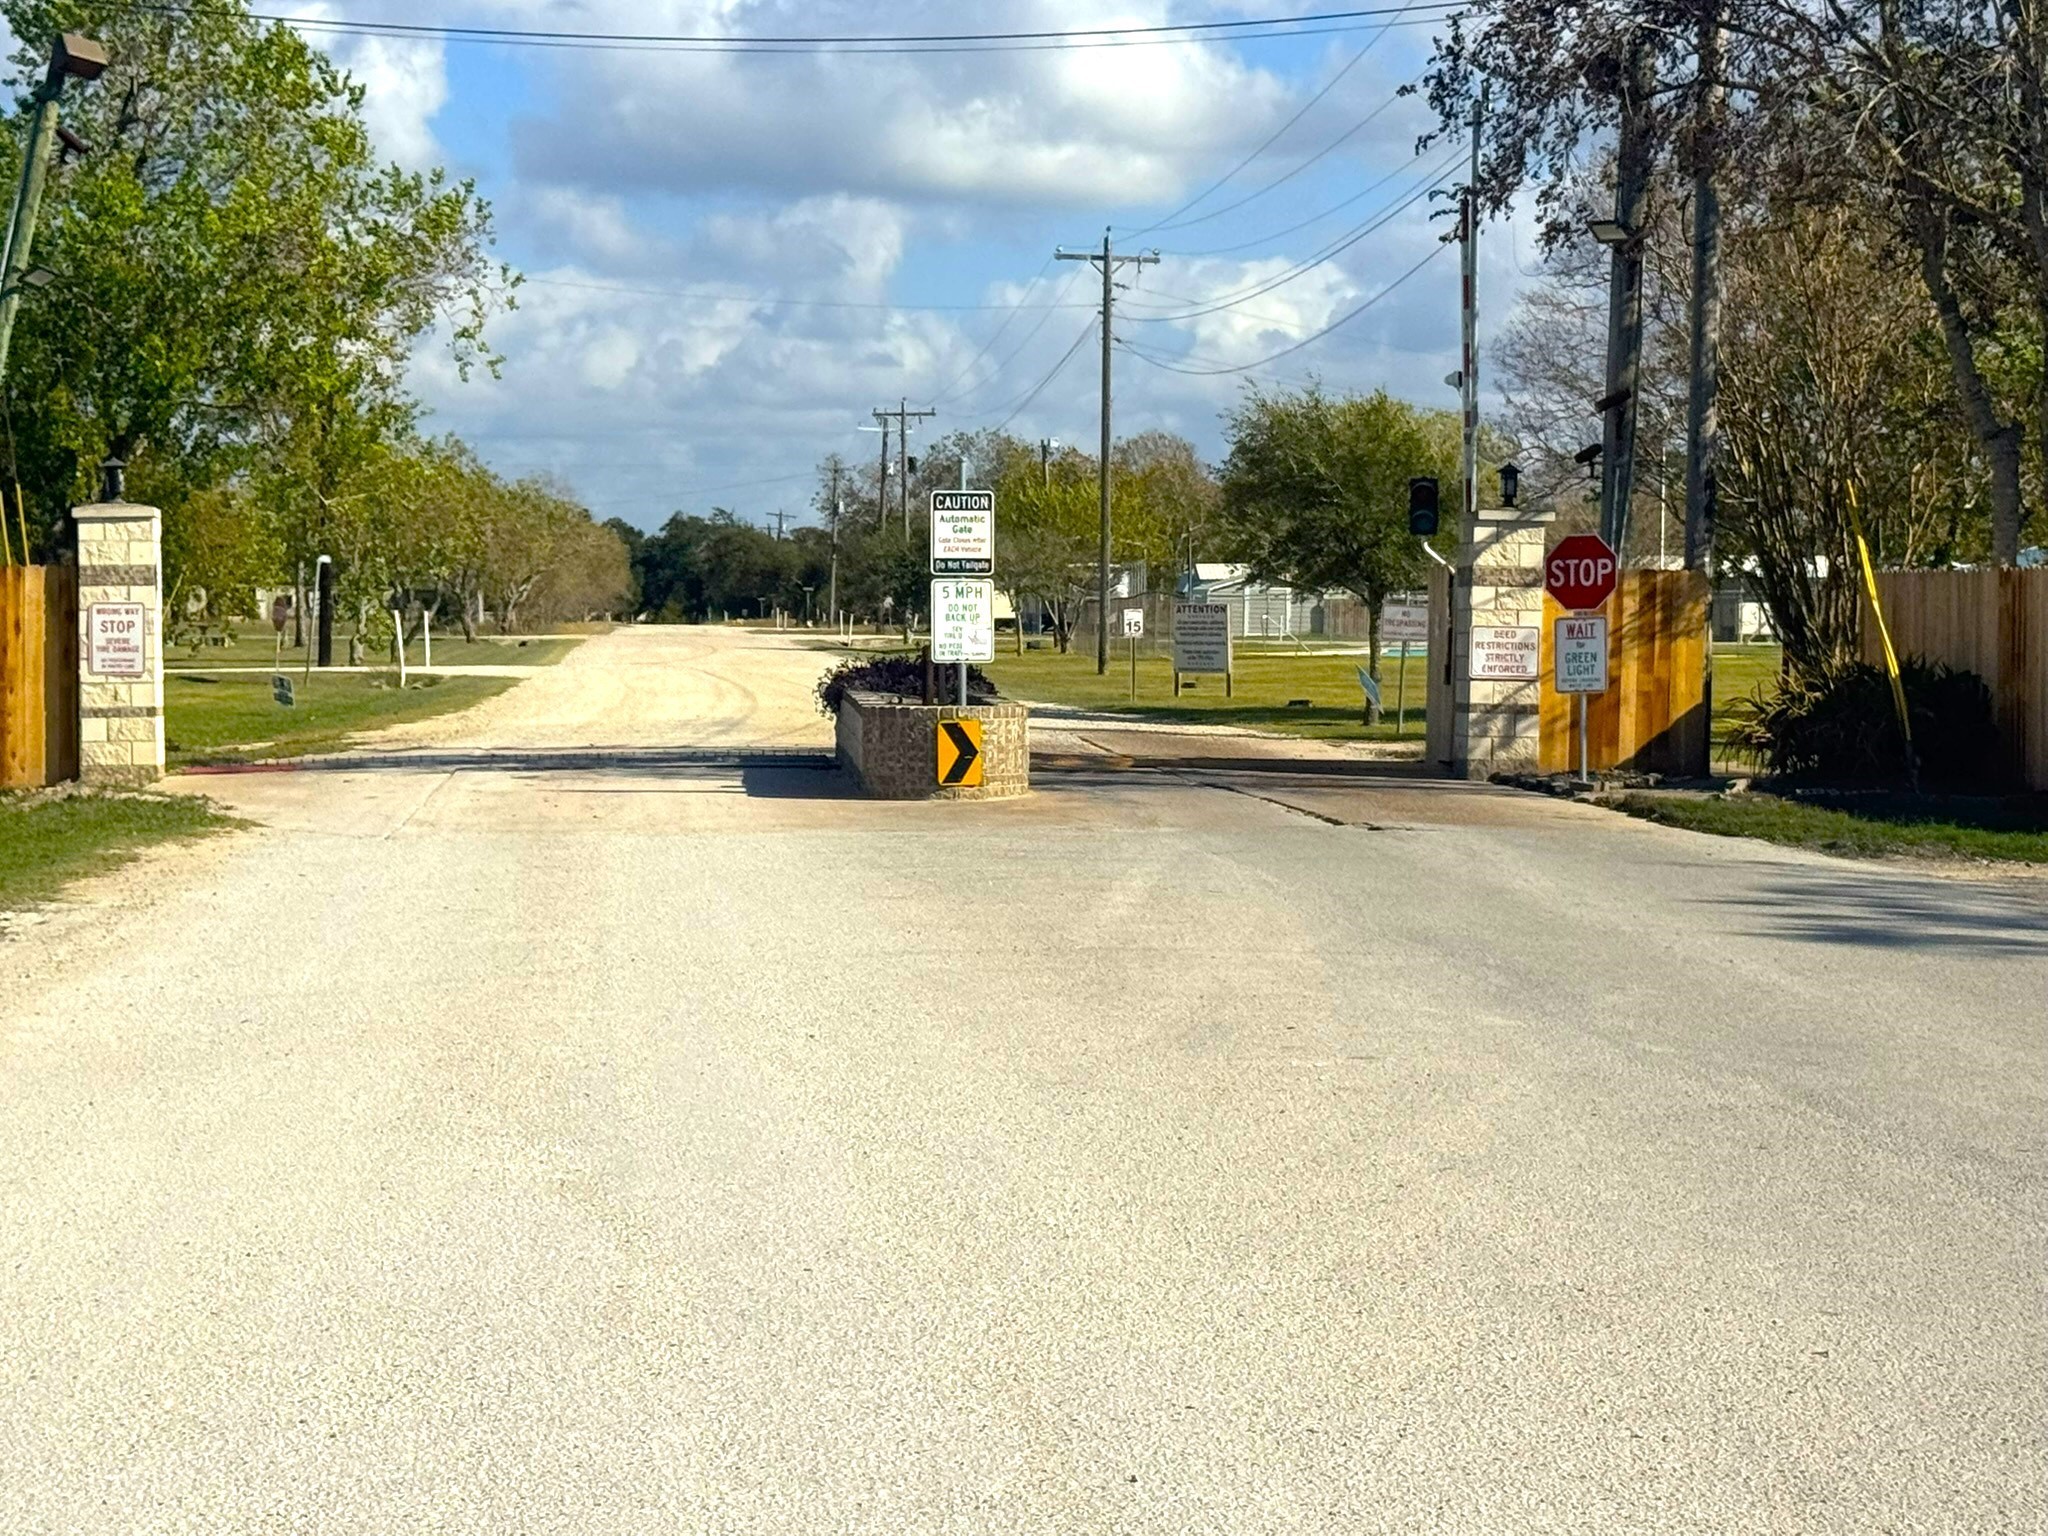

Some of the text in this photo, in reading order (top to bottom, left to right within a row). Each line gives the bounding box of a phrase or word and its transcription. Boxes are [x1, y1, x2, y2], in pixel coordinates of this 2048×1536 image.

[936, 495, 989, 510] CAUTION
[940, 514, 986, 523] Automatic
[952, 525, 972, 534] Gate
[936, 560, 990, 571] Do Not Tailgate
[1550, 558, 1612, 588] STOP
[942, 586, 982, 599] 5 MPH
[948, 604, 978, 612] DO NOT
[1176, 604, 1227, 614] ATTENTION
[945, 613, 980, 622] BACK UP
[100, 620, 135, 633] STOP
[1126, 620, 1141, 632] 15
[1566, 622, 1596, 638] WAIT
[1494, 630, 1516, 638] DEED
[1475, 642, 1536, 650] RESTRICTIONS
[1485, 653, 1524, 663] STRICTLY
[1565, 652, 1598, 664] GREEN
[1482, 664, 1528, 674] ENFORCED
[1567, 664, 1596, 676] LIGHT
